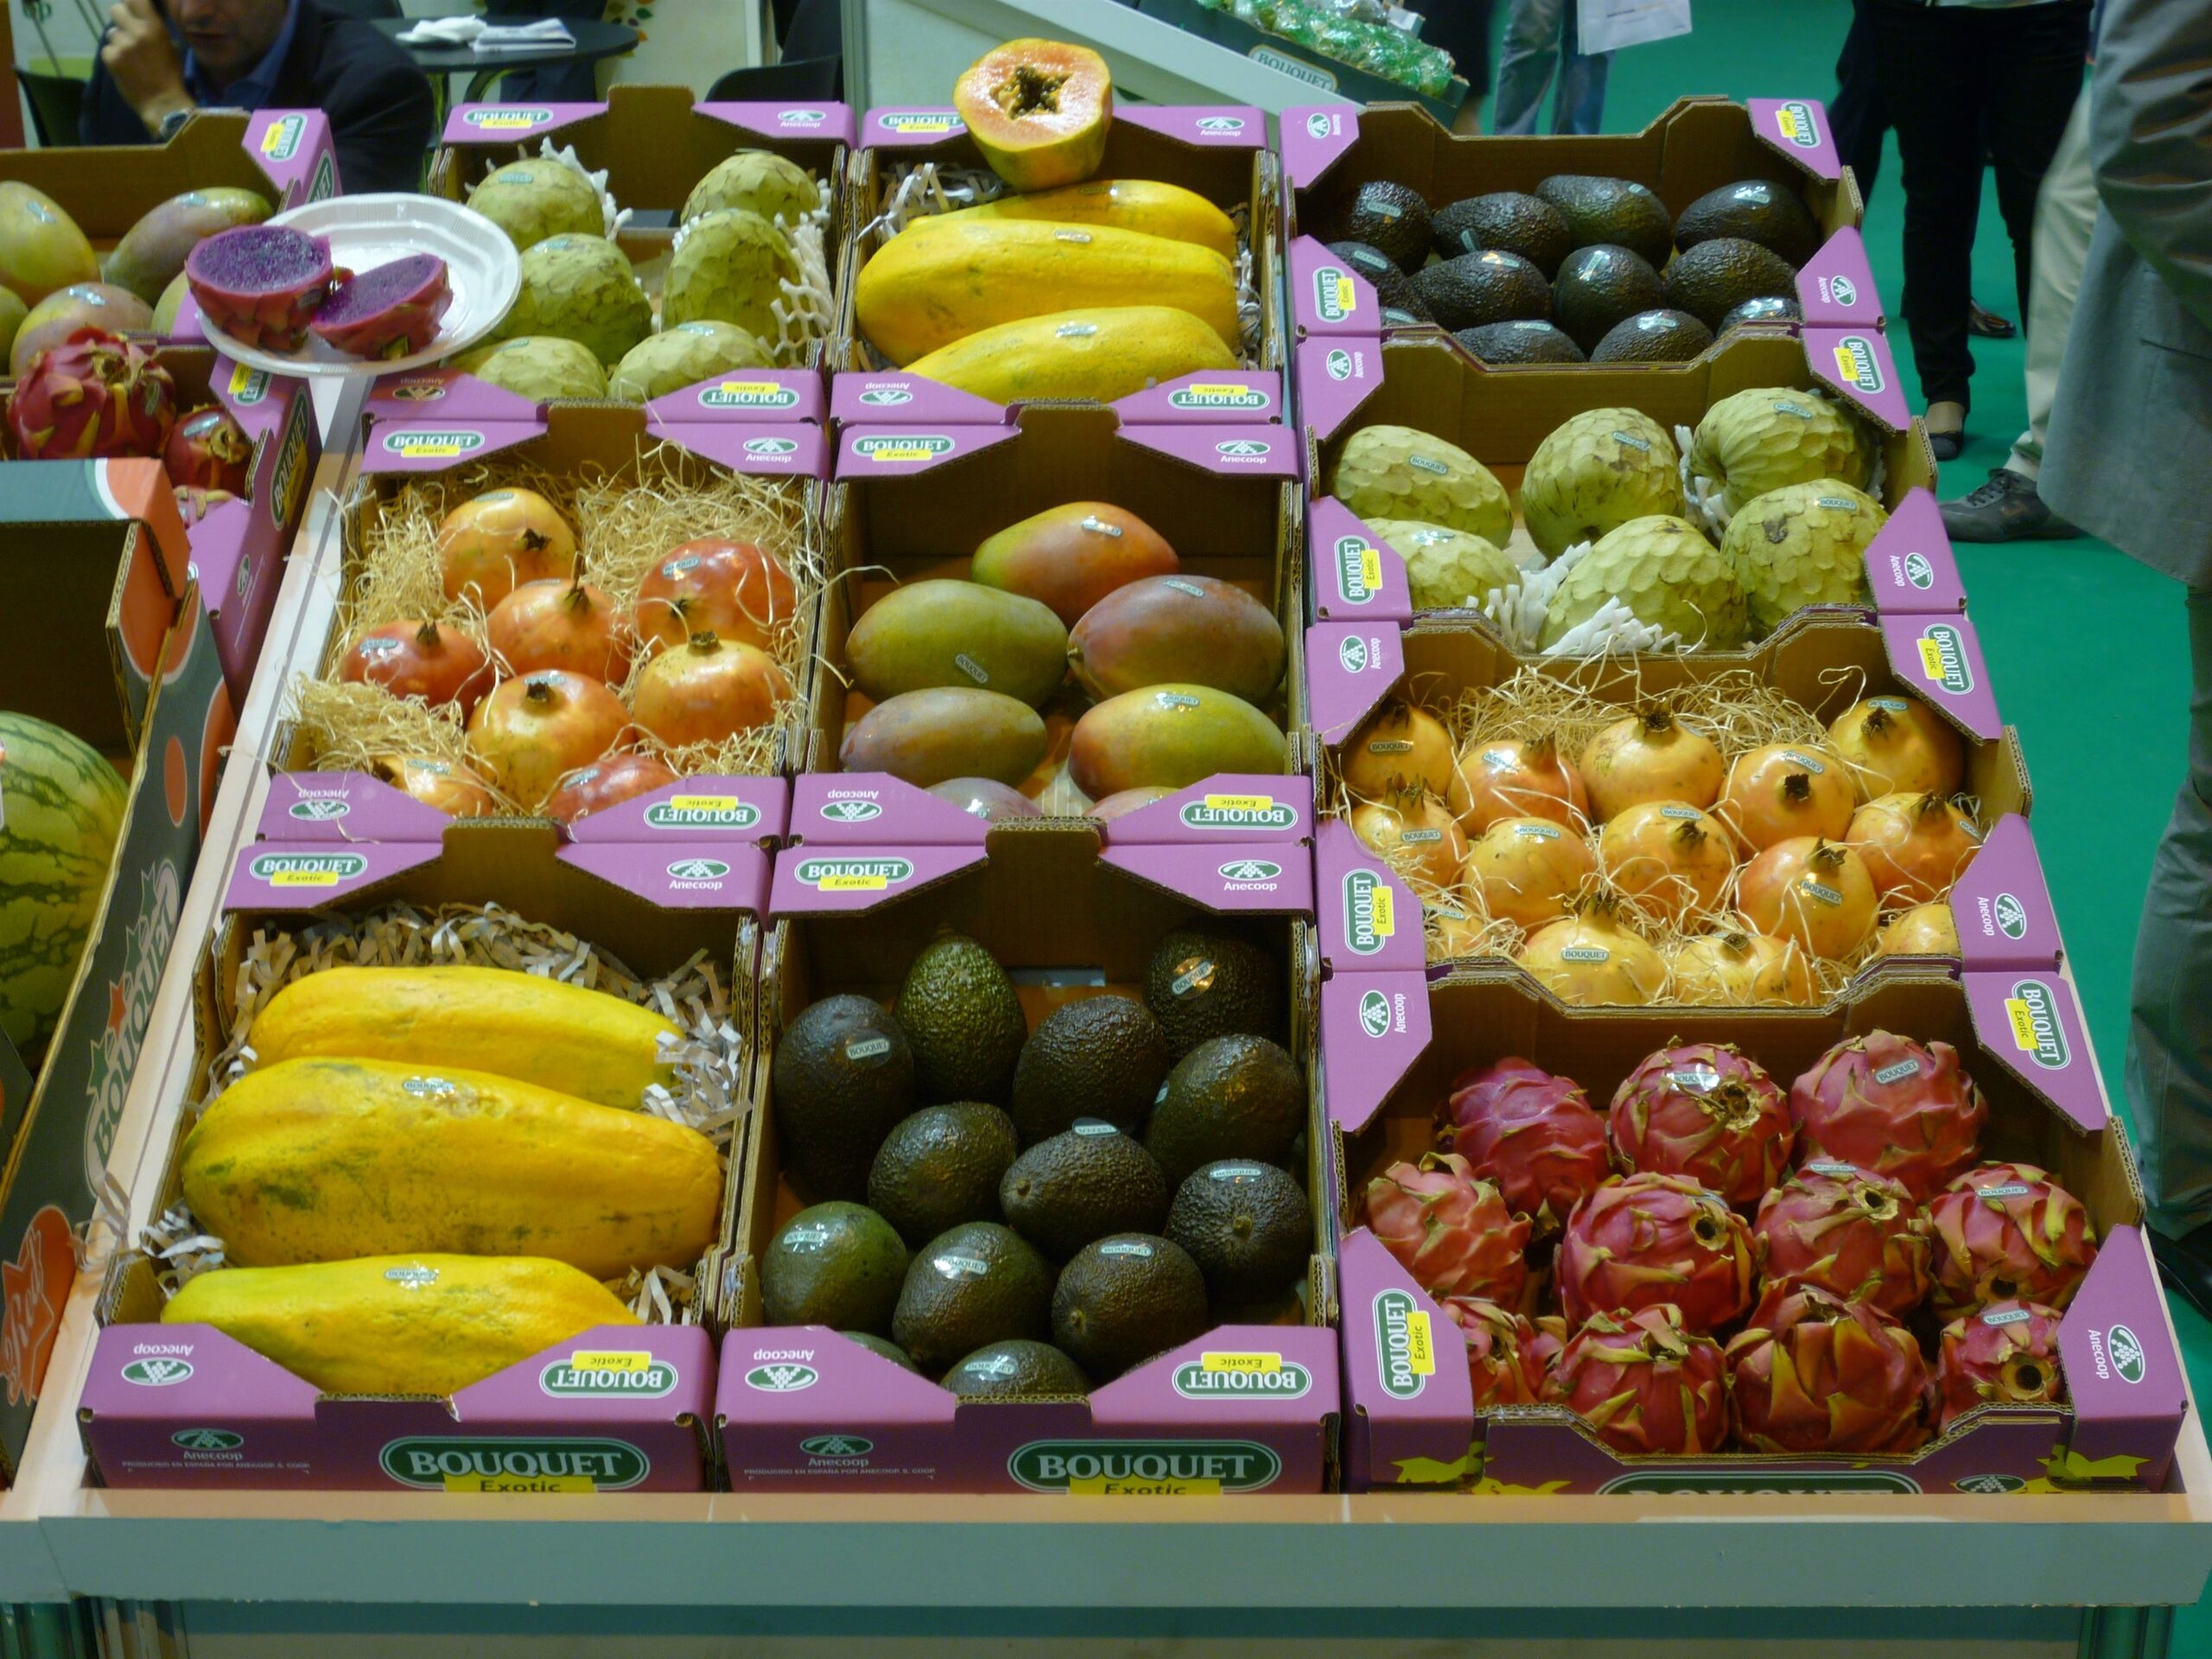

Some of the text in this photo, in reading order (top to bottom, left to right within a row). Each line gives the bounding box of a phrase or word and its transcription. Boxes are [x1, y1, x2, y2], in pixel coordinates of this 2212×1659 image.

[1257, 52, 1331, 90] BOUQUET
[1789, 105, 1814, 143] BOUQUET
[1322, 272, 1340, 316] BOUQUET
[1847, 341, 1877, 389] BOUQUET
[708, 391, 788, 404] BOUQUET
[1178, 394, 1259, 404] BOUQUET
[393, 435, 476, 448] BOUQUET
[862, 440, 945, 452] BOUQUET
[274, 405, 306, 515] BOUQUET
[745, 454, 791, 463] Anecoop
[1220, 455, 1267, 464] Anecoop
[1411, 456, 1446, 473] BOUQUET
[1821, 499, 1855, 508] BOUQUET
[1344, 542, 1365, 598] BOUQUET
[1890, 555, 1905, 588] Anecoop
[1370, 638, 1382, 670] Anecoop
[1925, 647, 1937, 671] Exotic
[1933, 630, 1964, 688] BOUQUET
[957, 655, 986, 683] BOUQUET
[1372, 742, 1410, 751] BOUQUET
[299, 790, 350, 799] Anecoop
[828, 790, 880, 799] Anecoop
[654, 808, 748, 823] BOUQUET
[1191, 808, 1286, 823] BOUQUET
[1403, 831, 1440, 841] BOUQUET
[262, 859, 357, 873] BOUQUET
[807, 864, 903, 878] BOUQUET
[669, 880, 722, 890] Anecoop
[1224, 881, 1278, 892] Anecoop
[1802, 882, 1842, 905] BOUQUET
[1353, 877, 1375, 946] BOUQUET
[1376, 897, 1387, 925] Exotic
[1977, 896, 1995, 936] Anecoop
[1565, 950, 1607, 960] BOUQUET
[1175, 963, 1210, 991] BOUQUET
[1394, 993, 1407, 1033] Anecoop
[92, 887, 172, 1169] BOUQUET
[2014, 1009, 2029, 1038] Exotic
[2022, 988, 2061, 1061] BOUQUET
[849, 1039, 887, 1057] BOUQUET
[1878, 1059, 1917, 1082] BOUQUET
[1103, 1247, 1149, 1256] BOUQUET
[1988, 1312, 2027, 1323] BOUQUET
[133, 1344, 194, 1356] Anecoop
[1385, 1299, 1414, 1388] BOUQUET
[1414, 1325, 1426, 1360] Exotic
[590, 1357, 632, 1366] Exotic
[753, 1349, 815, 1361] Anecoop
[2088, 1329, 2110, 1379] Anecoop
[1220, 1358, 1262, 1368] Exotic
[552, 1369, 664, 1388] BOUQUET
[1185, 1370, 1297, 1389] BOUQUET
[183, 1452, 243, 1461] Anecoop
[408, 1451, 622, 1478] BOUQUET
[808, 1458, 869, 1467] Anecoop
[1037, 1453, 1255, 1480] BOUQUET
[479, 1479, 562, 1493] Exotic
[1103, 1482, 1187, 1495] Exotic
